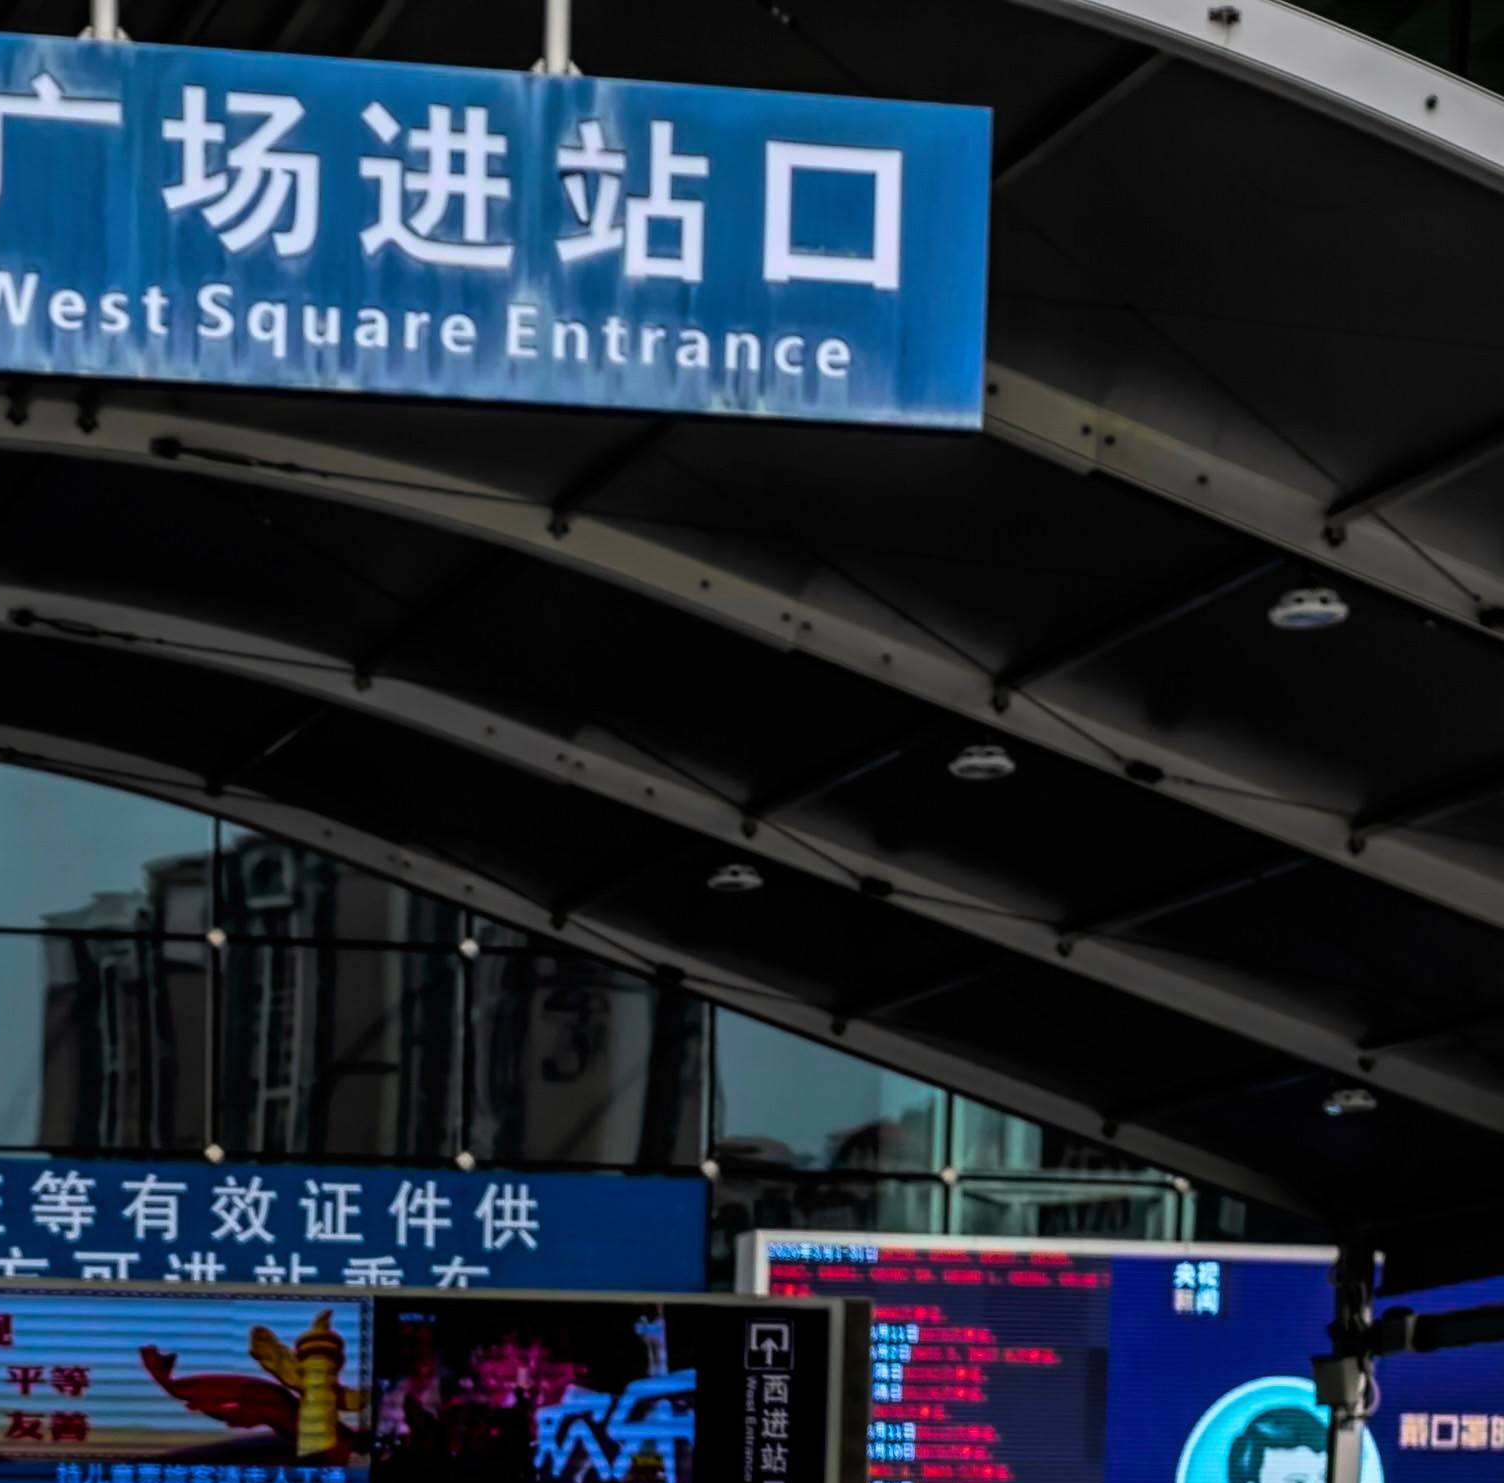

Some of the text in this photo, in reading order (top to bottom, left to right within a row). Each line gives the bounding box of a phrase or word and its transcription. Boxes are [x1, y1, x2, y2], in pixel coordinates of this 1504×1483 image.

[197, 283, 477, 358] Square
[505, 303, 853, 380] Entrance
[7, 1365, 90, 1397] 平等
[6, 1411, 90, 1442] 友善
